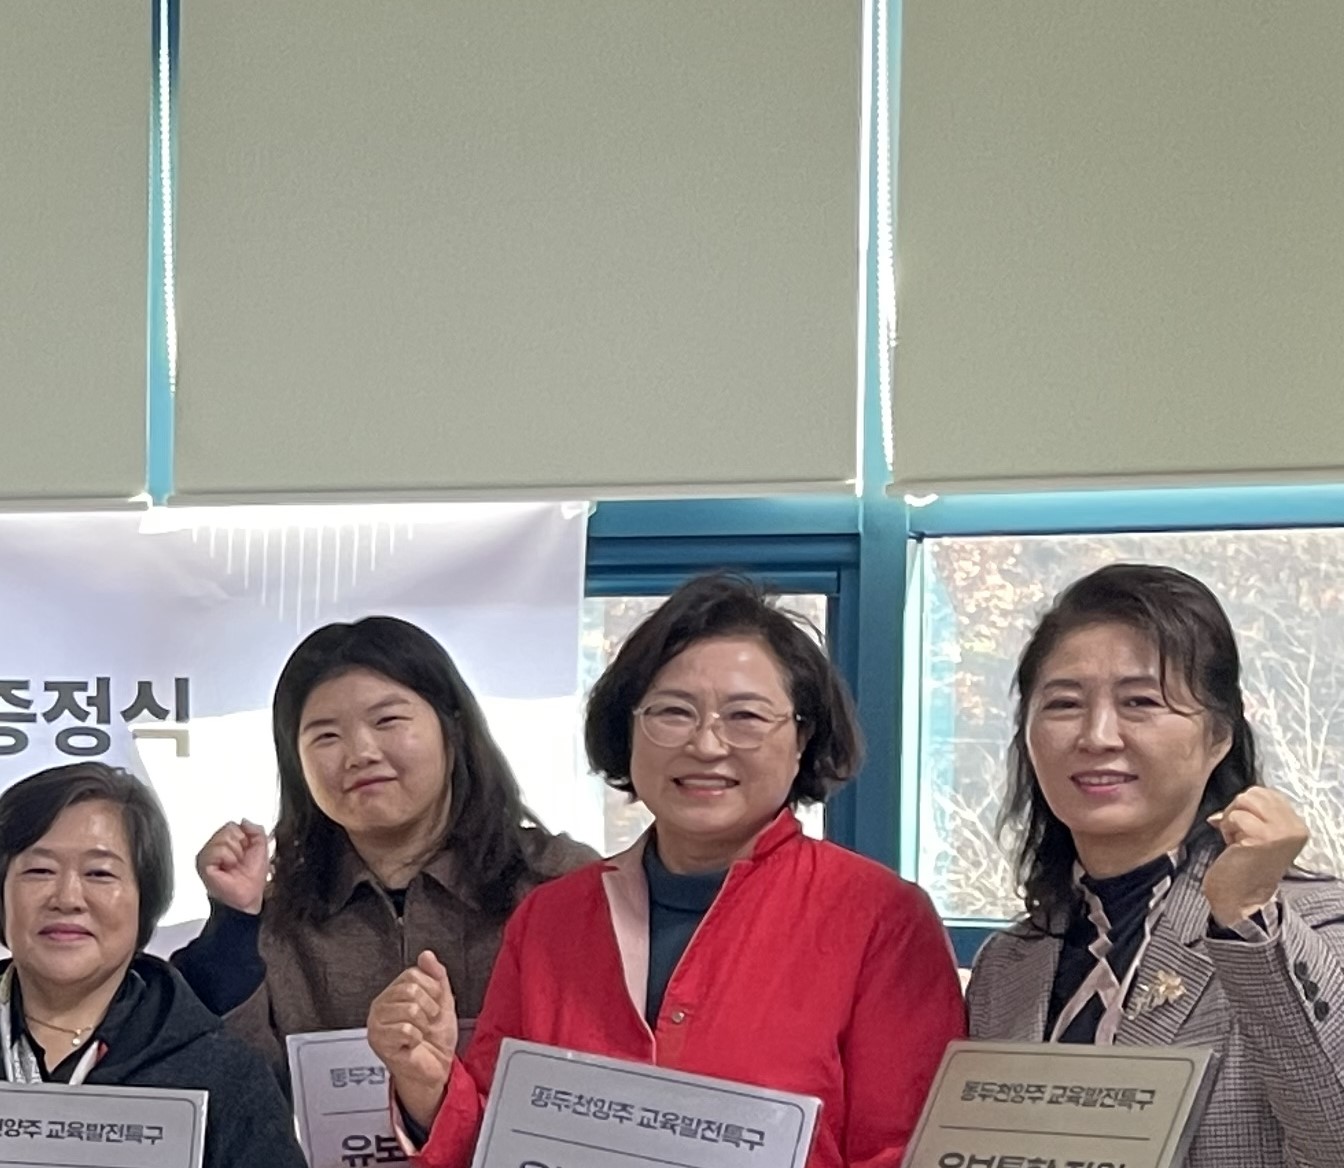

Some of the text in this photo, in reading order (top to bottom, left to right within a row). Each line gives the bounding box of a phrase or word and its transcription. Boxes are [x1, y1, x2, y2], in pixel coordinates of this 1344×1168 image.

[330, 1066, 385, 1087] 동두천
[960, 1080, 1156, 1111] 동두천양주 교육발전특구
[530, 1085, 766, 1151] 동두천양주 교육발전특구
[45, 1120, 163, 1144] 교육발전특구
